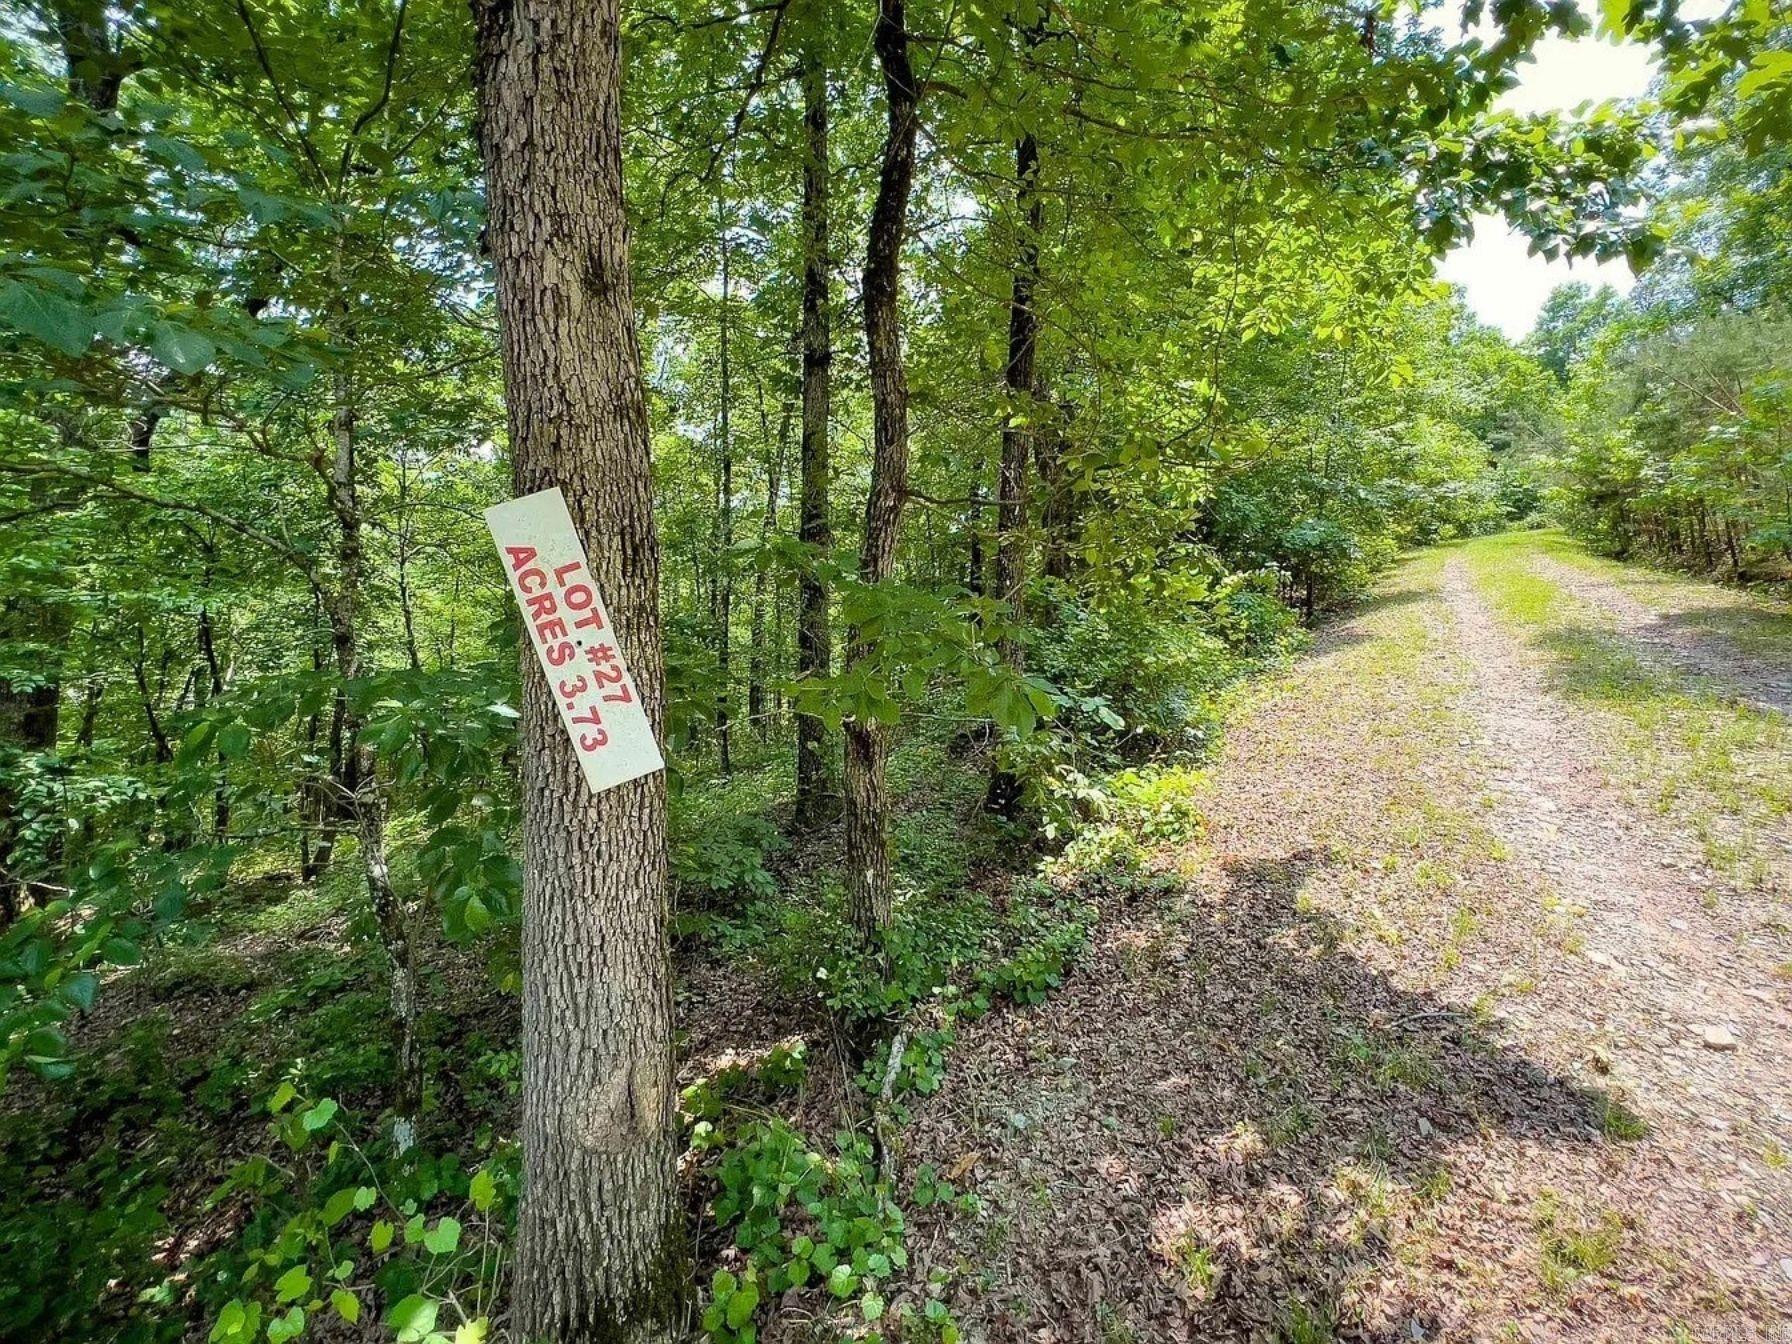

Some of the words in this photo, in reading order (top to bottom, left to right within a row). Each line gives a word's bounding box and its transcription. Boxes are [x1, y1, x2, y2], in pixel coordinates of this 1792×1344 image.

[505, 546, 577, 668] ACRES
[558, 675, 610, 754] 3.73
[553, 561, 604, 631] LOT
[584, 643, 633, 704] #27
